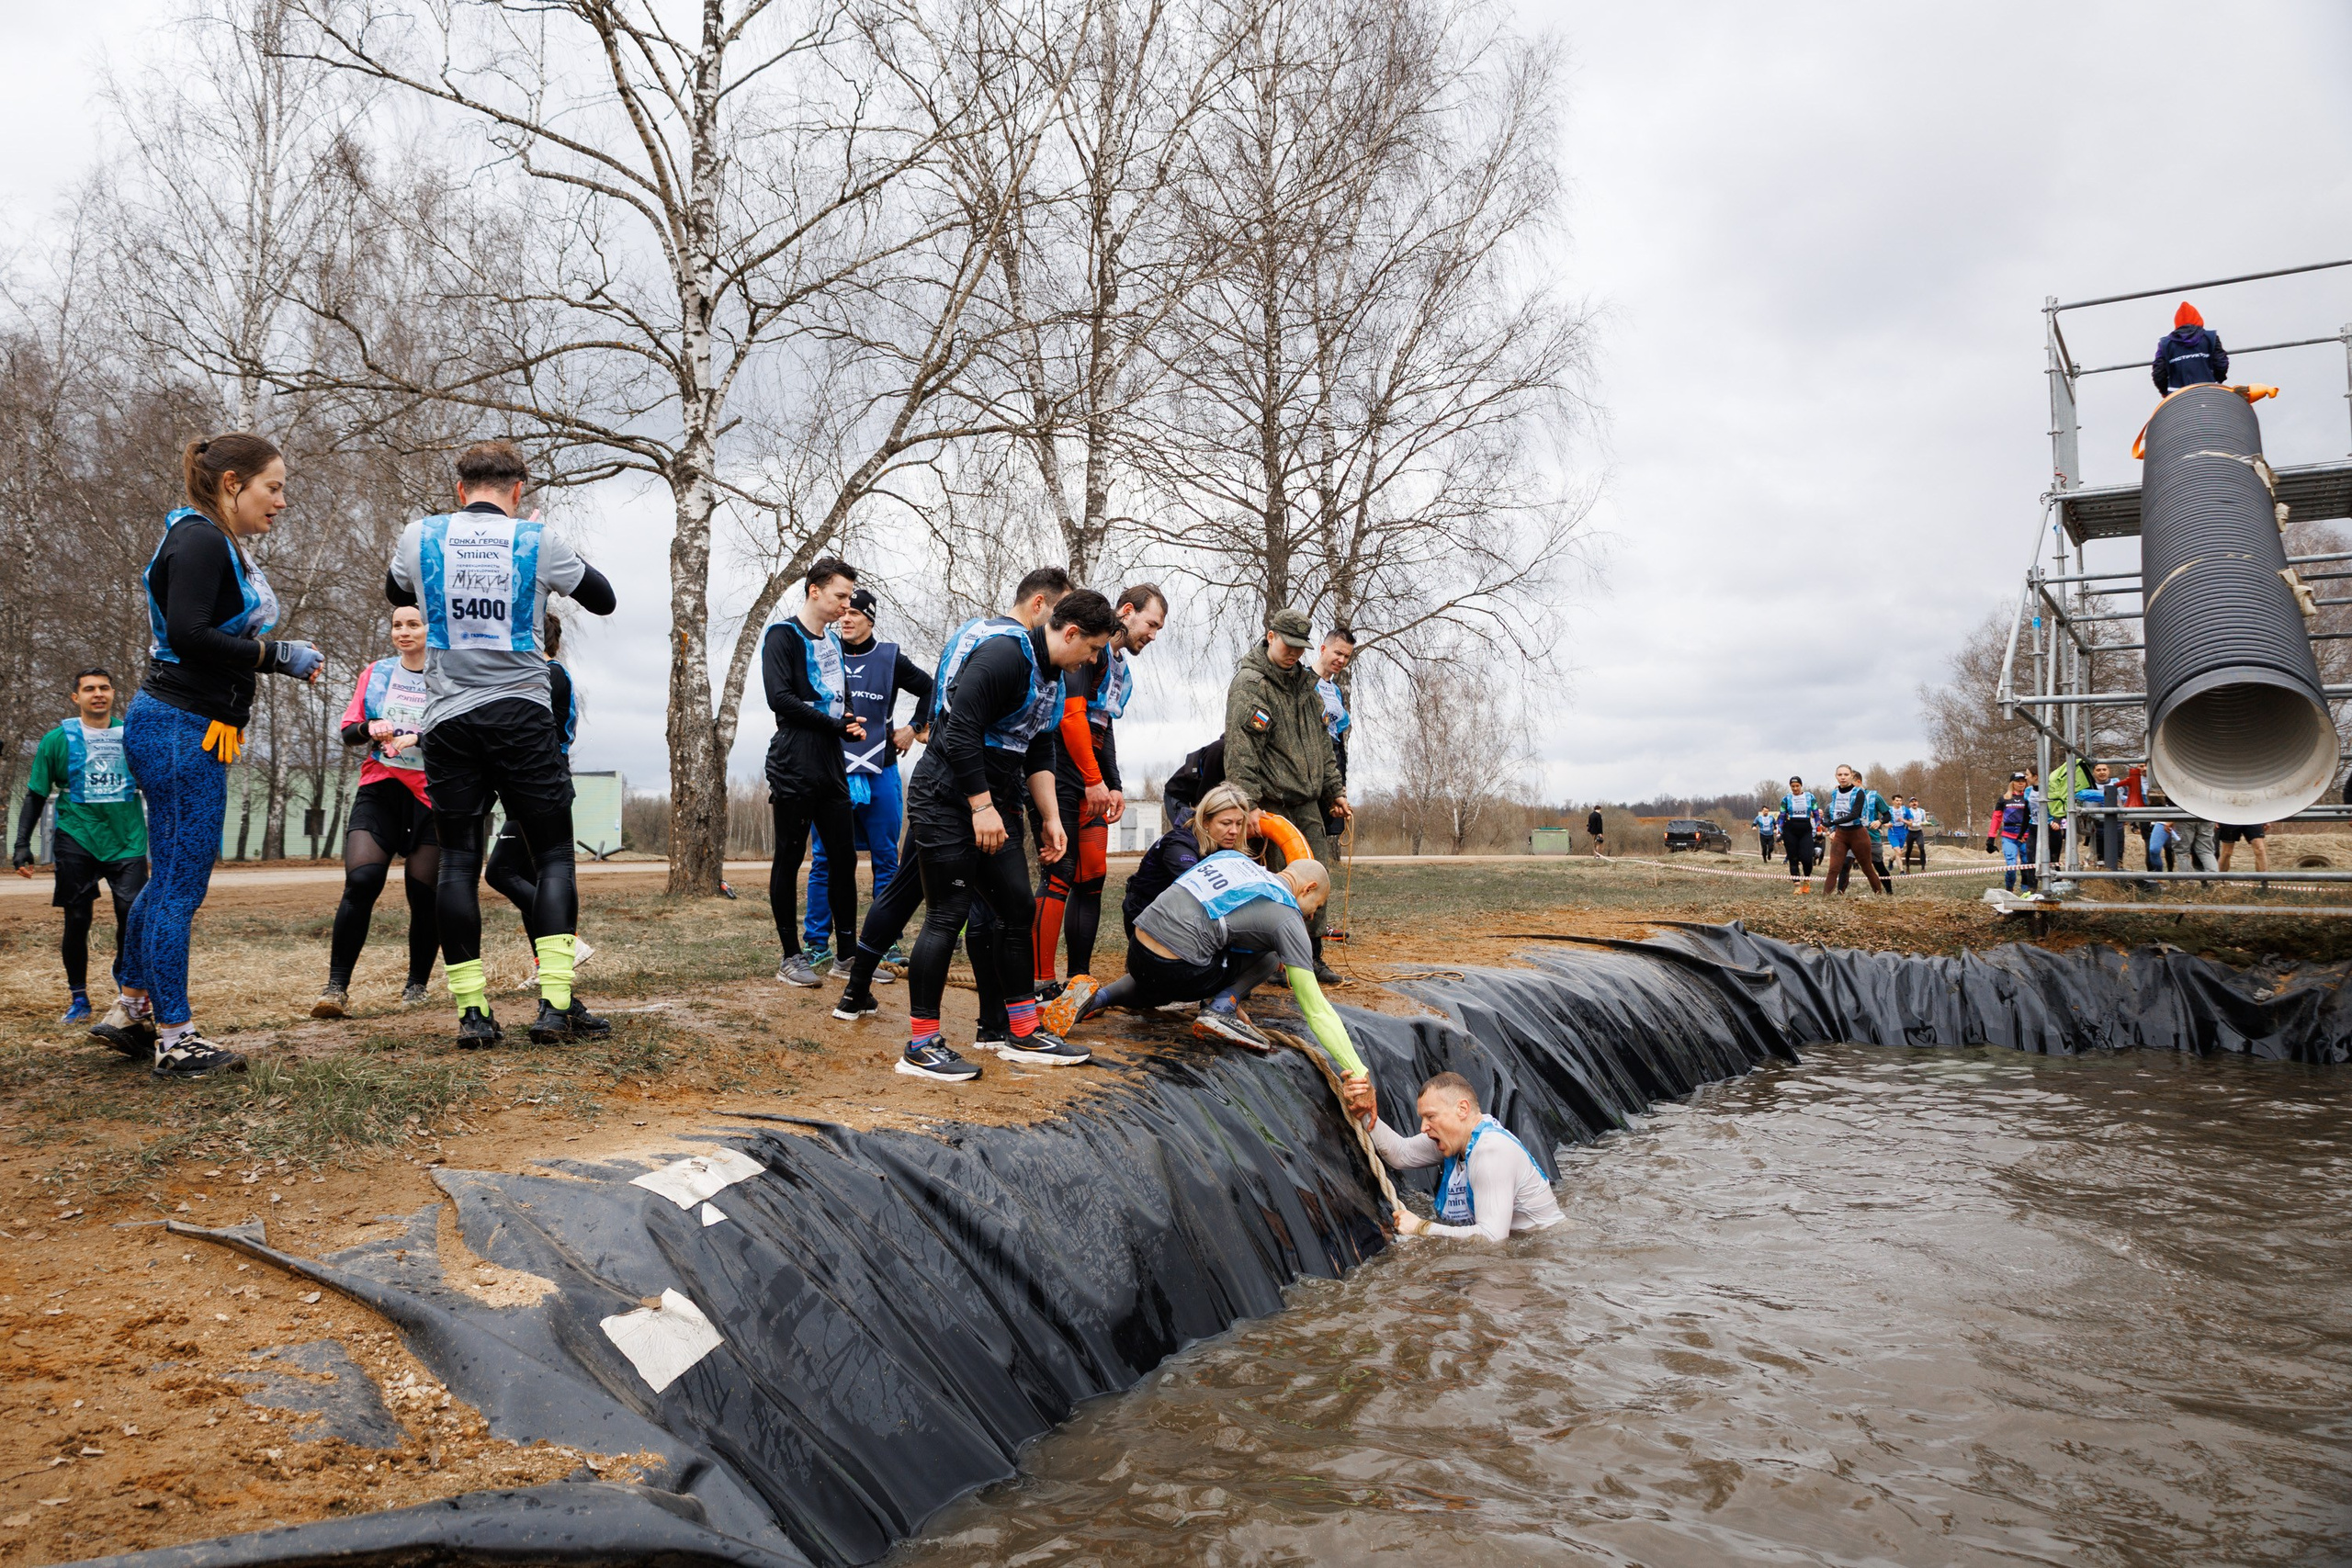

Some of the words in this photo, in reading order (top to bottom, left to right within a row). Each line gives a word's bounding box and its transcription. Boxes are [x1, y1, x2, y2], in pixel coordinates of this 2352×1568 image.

[457, 549, 499, 559] Sminex
[452, 598, 505, 621] 5400
[90, 773, 123, 785] 5411
[1197, 864, 1228, 890] 5410
